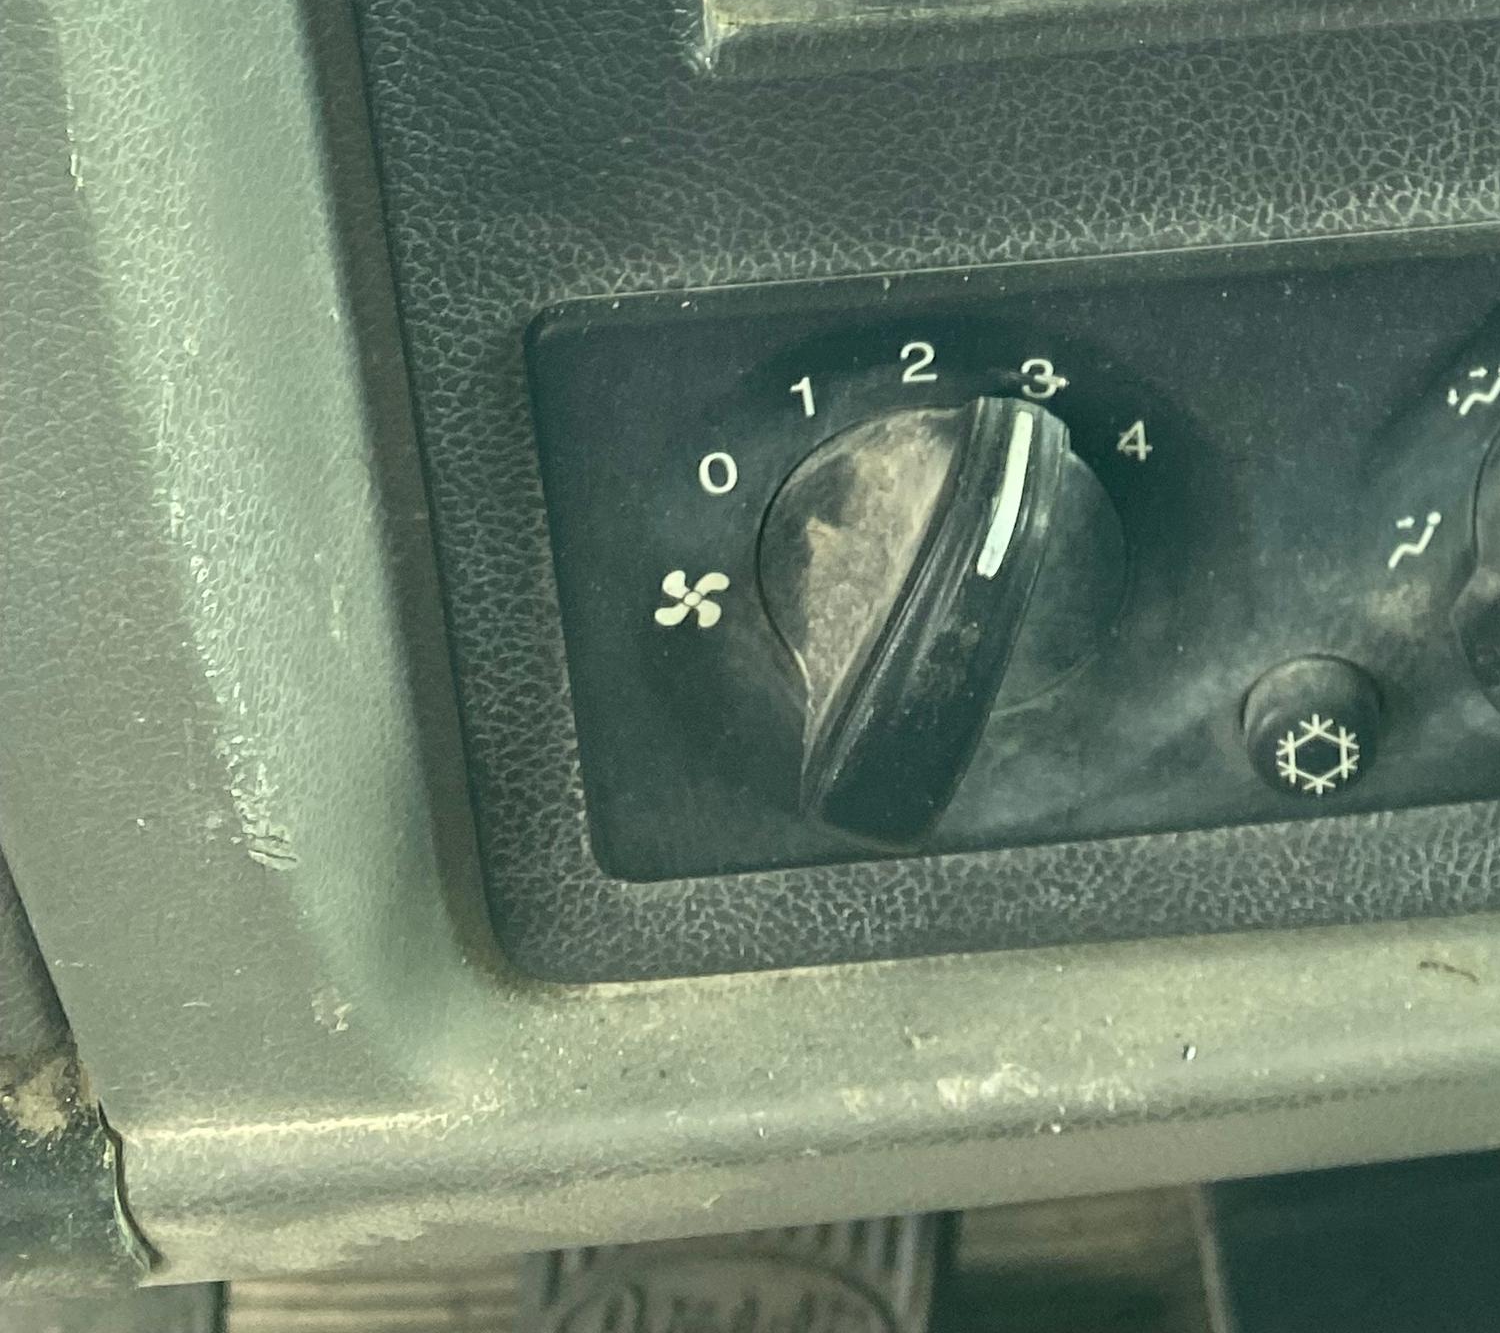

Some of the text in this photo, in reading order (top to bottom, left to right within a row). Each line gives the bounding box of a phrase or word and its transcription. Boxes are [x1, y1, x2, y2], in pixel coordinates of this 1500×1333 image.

[698, 341, 1153, 495] 0 1 2 3 4
